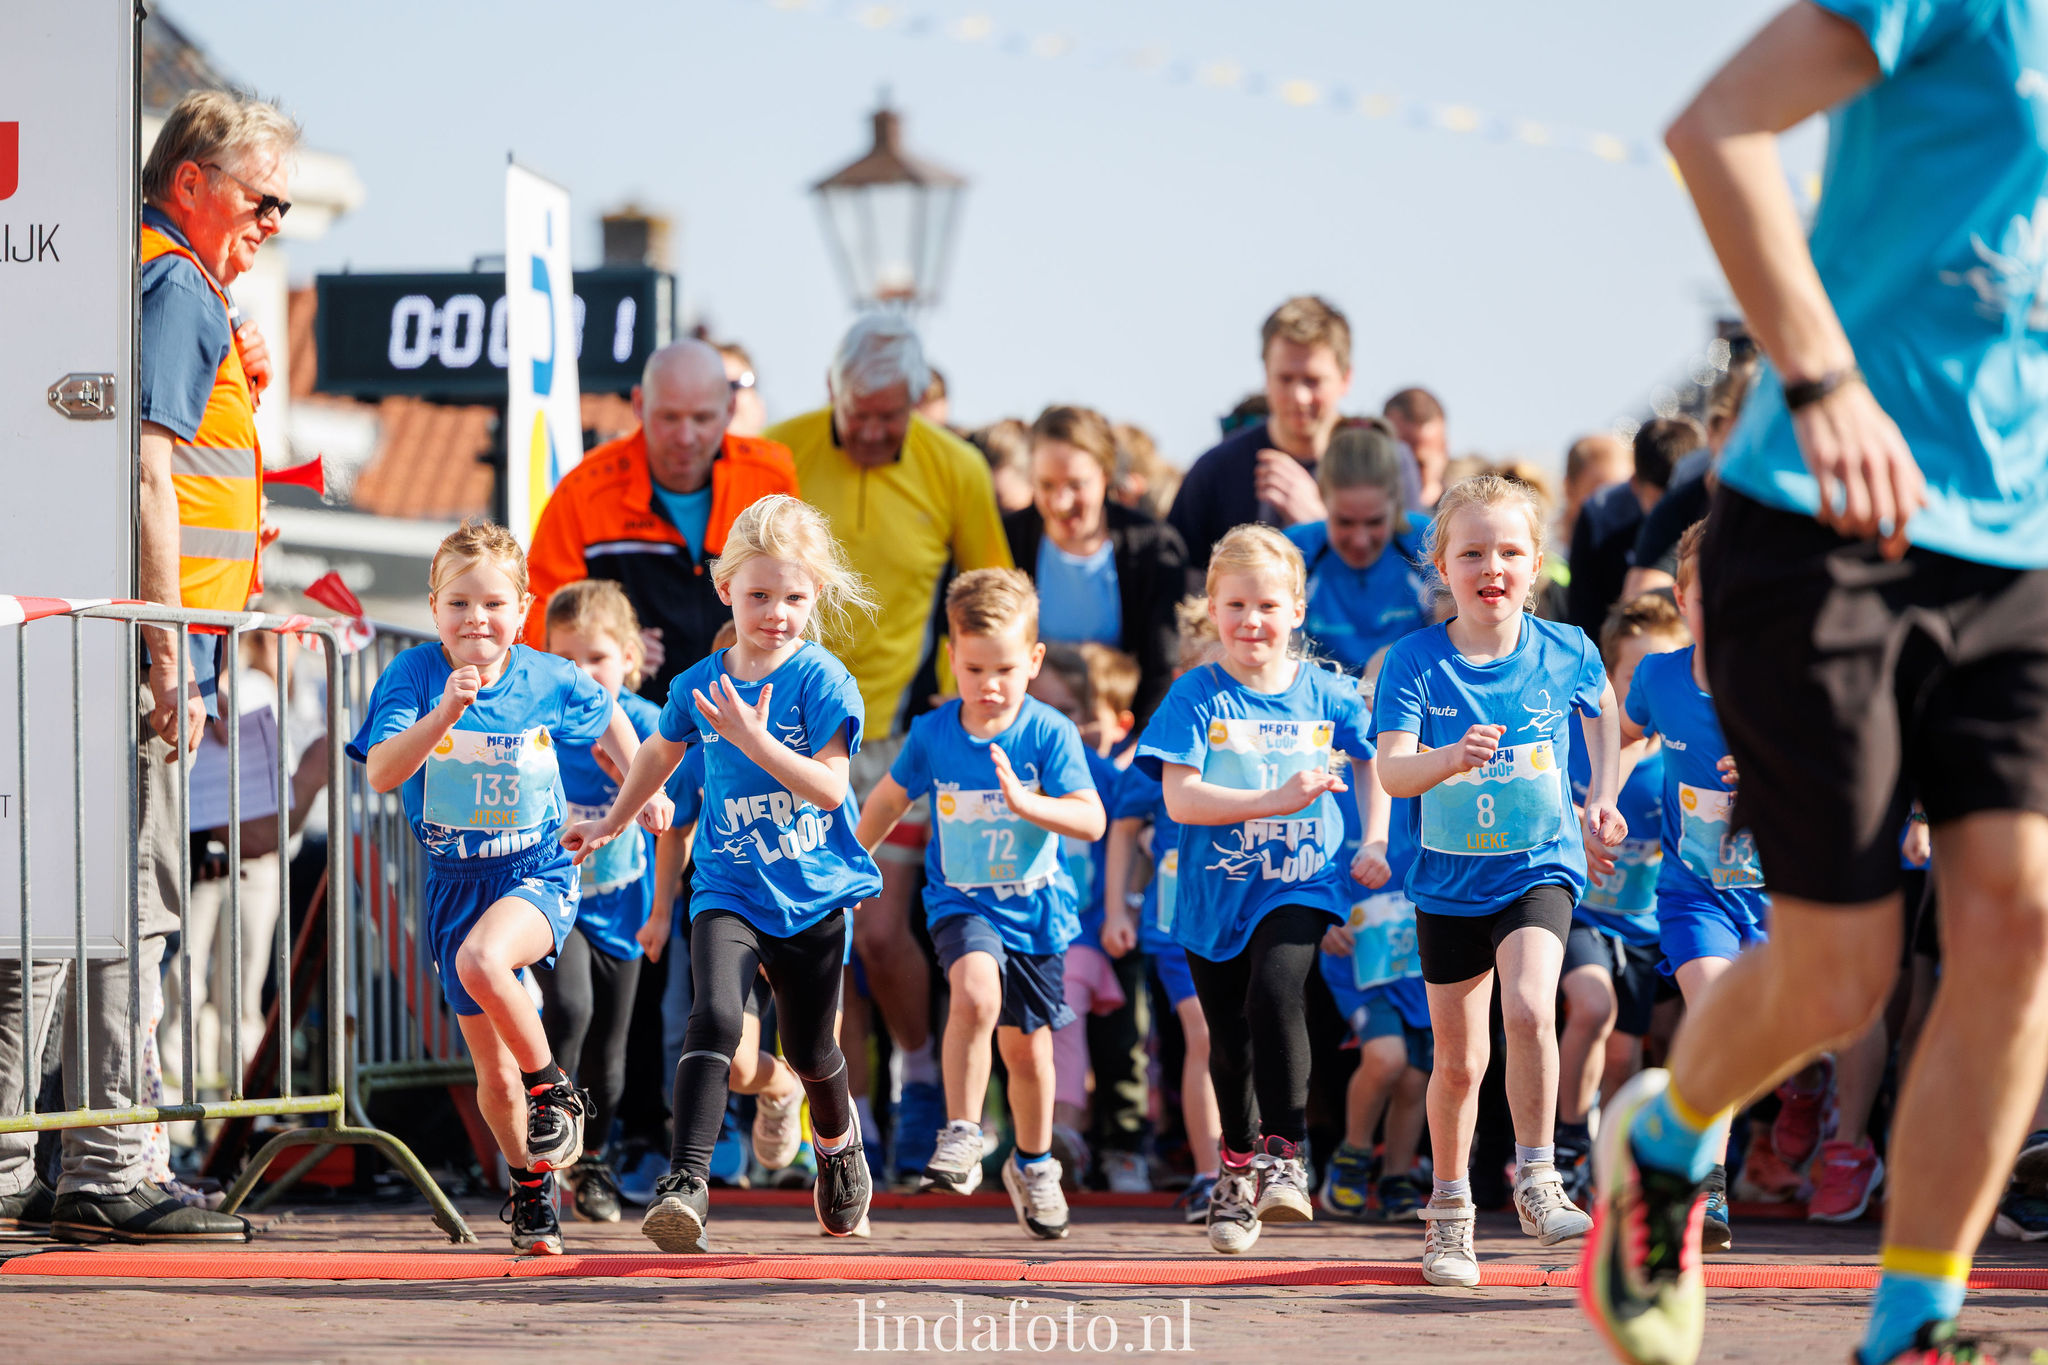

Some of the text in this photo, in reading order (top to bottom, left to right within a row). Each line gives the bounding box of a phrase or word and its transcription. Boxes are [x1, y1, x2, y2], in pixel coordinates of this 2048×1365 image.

[0, 224, 60, 263] IJK
[1259, 723, 1299, 736] MEREN
[1266, 735, 1298, 749] LOOP
[494, 748, 520, 762] LOO
[1257, 763, 1279, 791] 11
[1478, 762, 1515, 779] LOOP
[472, 772, 521, 806] 133
[469, 809, 520, 825] JITSKE
[724, 791, 824, 834] MER
[1476, 793, 1496, 829] 8
[750, 812, 834, 866] LOOP
[981, 828, 1018, 862] 72
[1466, 832, 1510, 849] LIEKE
[1719, 832, 1753, 865] 63
[990, 863, 1017, 880] KES
[1261, 843, 1326, 883] LOOP
